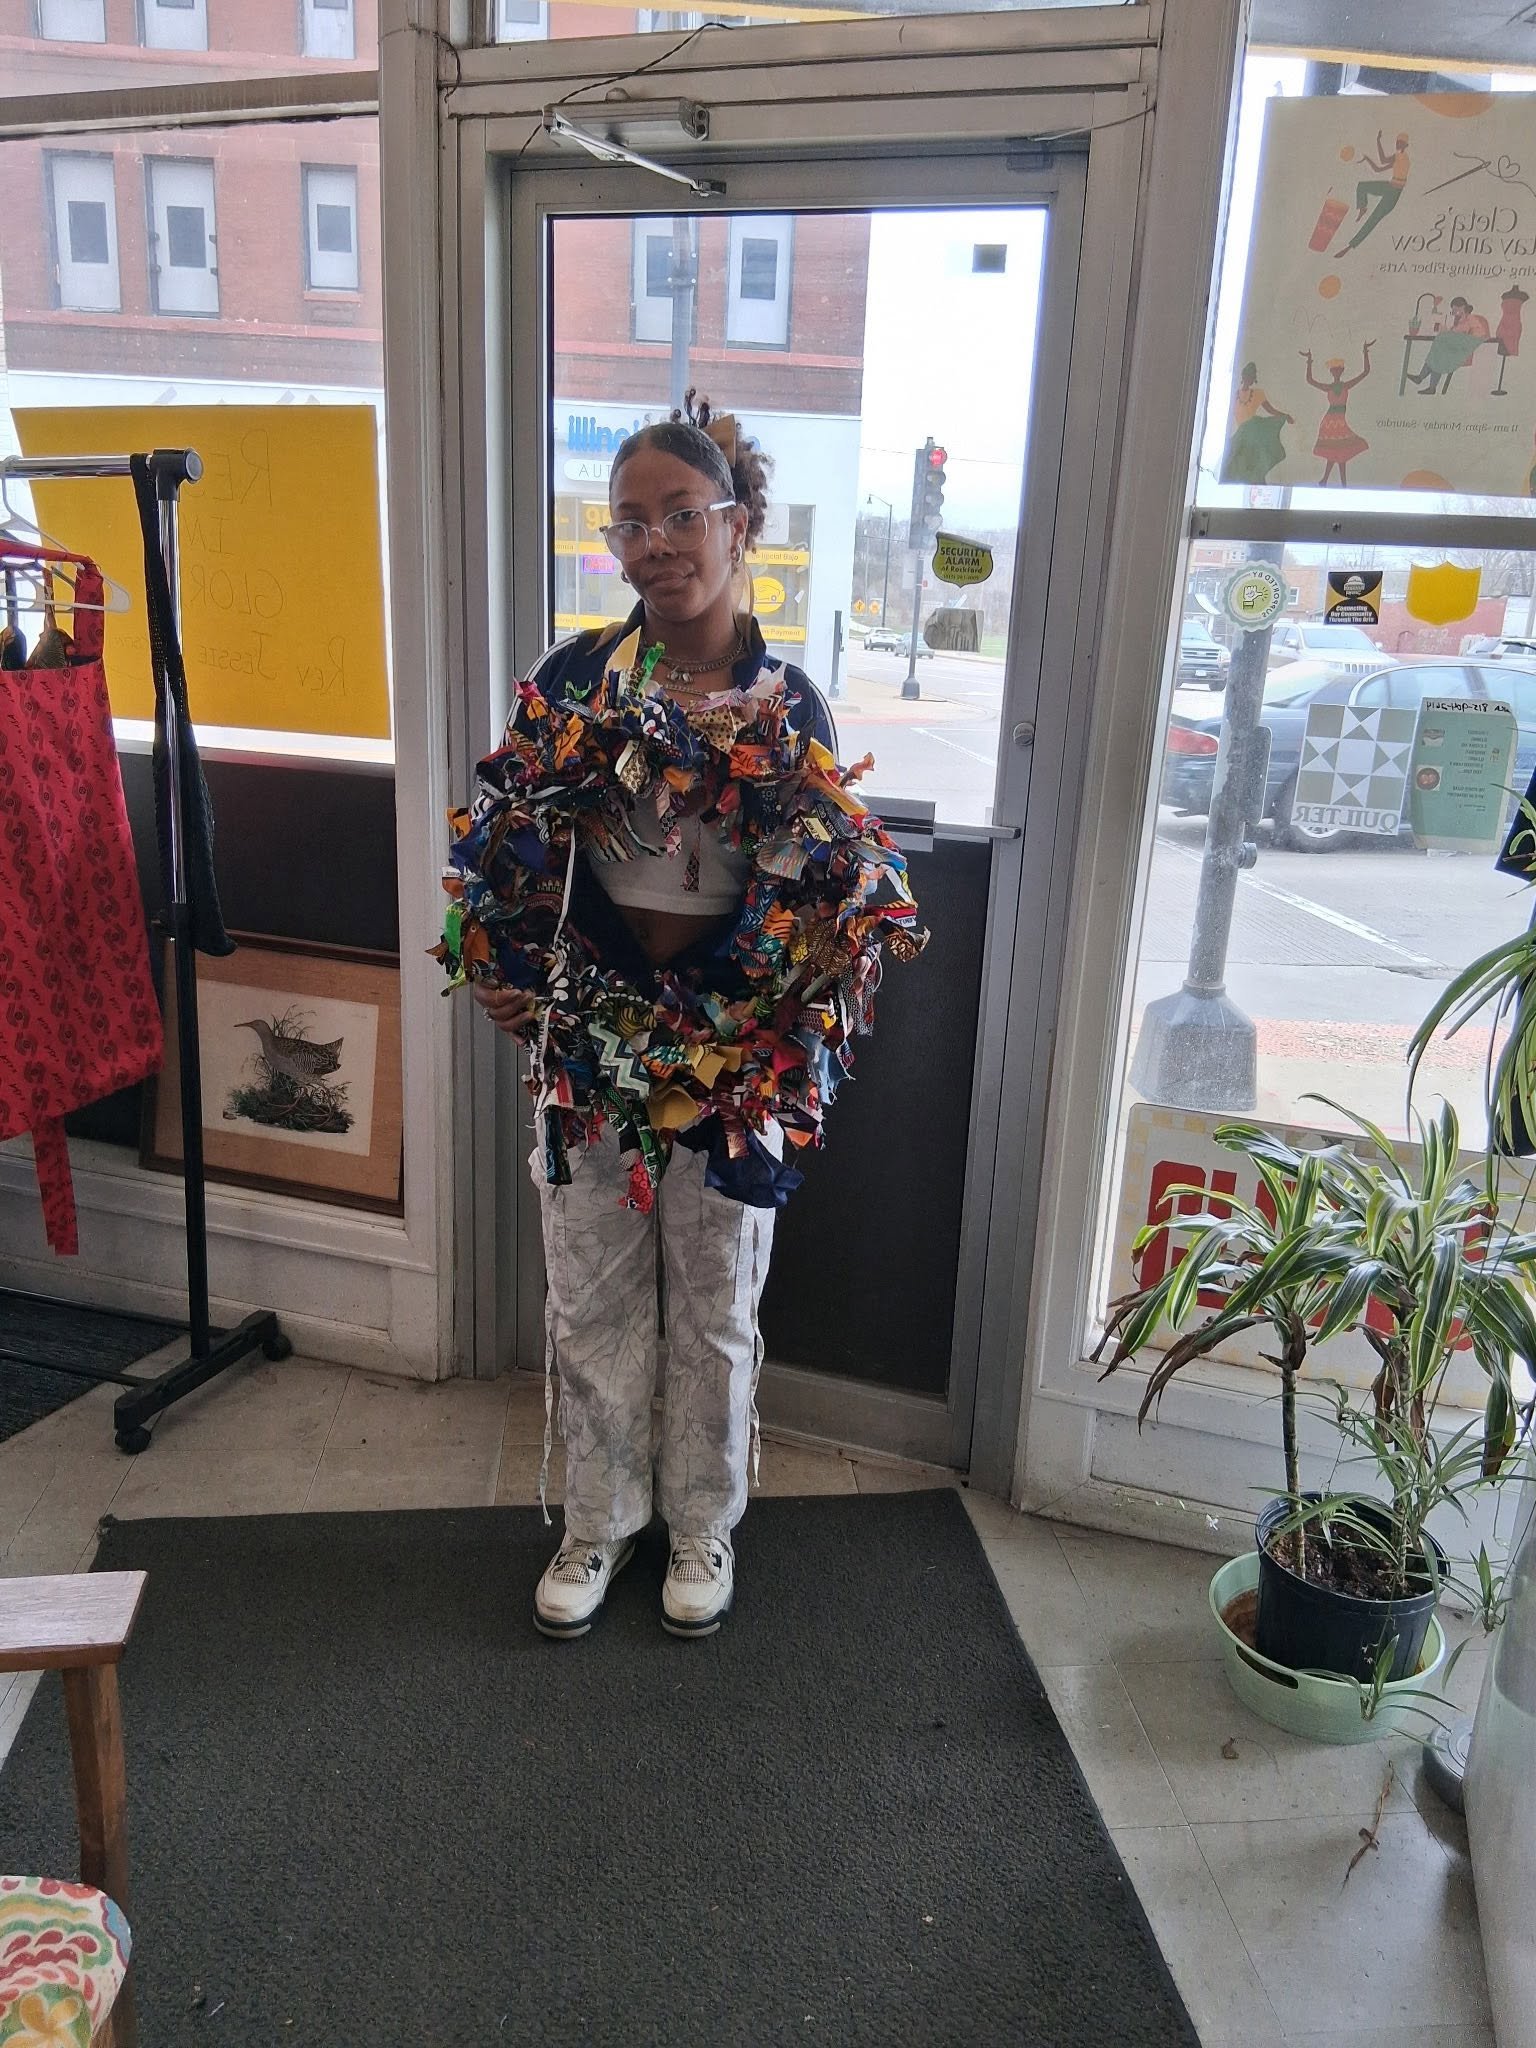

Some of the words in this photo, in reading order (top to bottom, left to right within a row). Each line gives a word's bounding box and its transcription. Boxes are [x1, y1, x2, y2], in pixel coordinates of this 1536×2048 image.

[945, 556, 980, 566] ALARM
[950, 566, 983, 574] Rockford
[770, 628, 801, 638] Payment
